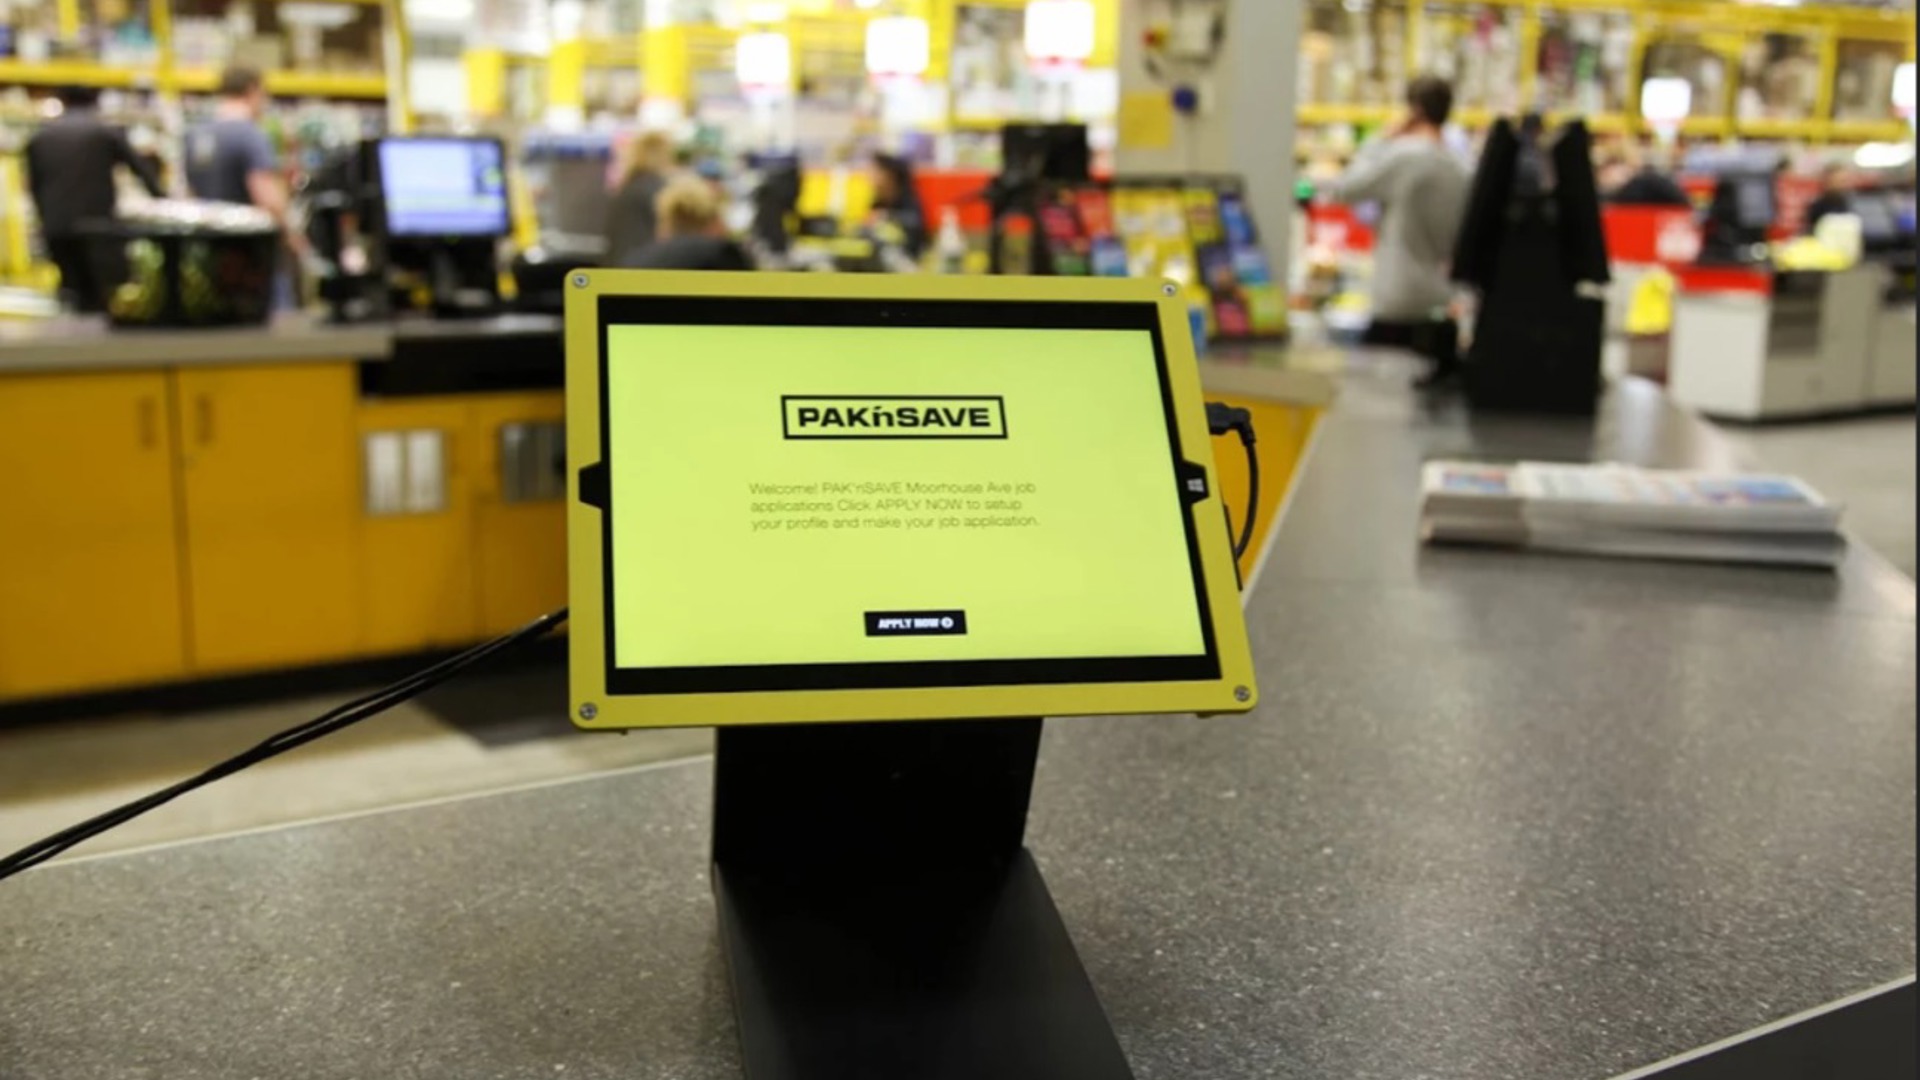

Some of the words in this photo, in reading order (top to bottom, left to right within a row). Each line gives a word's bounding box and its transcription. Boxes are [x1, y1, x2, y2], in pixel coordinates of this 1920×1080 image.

[749, 482, 818, 494] Welcome!
[906, 482, 983, 494] Moorhouse
[987, 481, 1012, 493] Ave
[1014, 482, 1037, 495] job
[750, 500, 833, 513] applications
[837, 499, 871, 511] Click
[876, 499, 921, 511] APPLY
[925, 498, 963, 511] NOW
[966, 499, 981, 510] to
[984, 499, 1022, 513] setup
[751, 519, 782, 532] your
[786, 516, 829, 531] profile
[832, 517, 860, 529] and
[863, 516, 901, 529] make
[904, 517, 935, 530] your
[938, 515, 960, 530] job
[964, 515, 1041, 529] application.
[878, 618, 911, 629] APPLY
[914, 618, 939, 629] NOW
